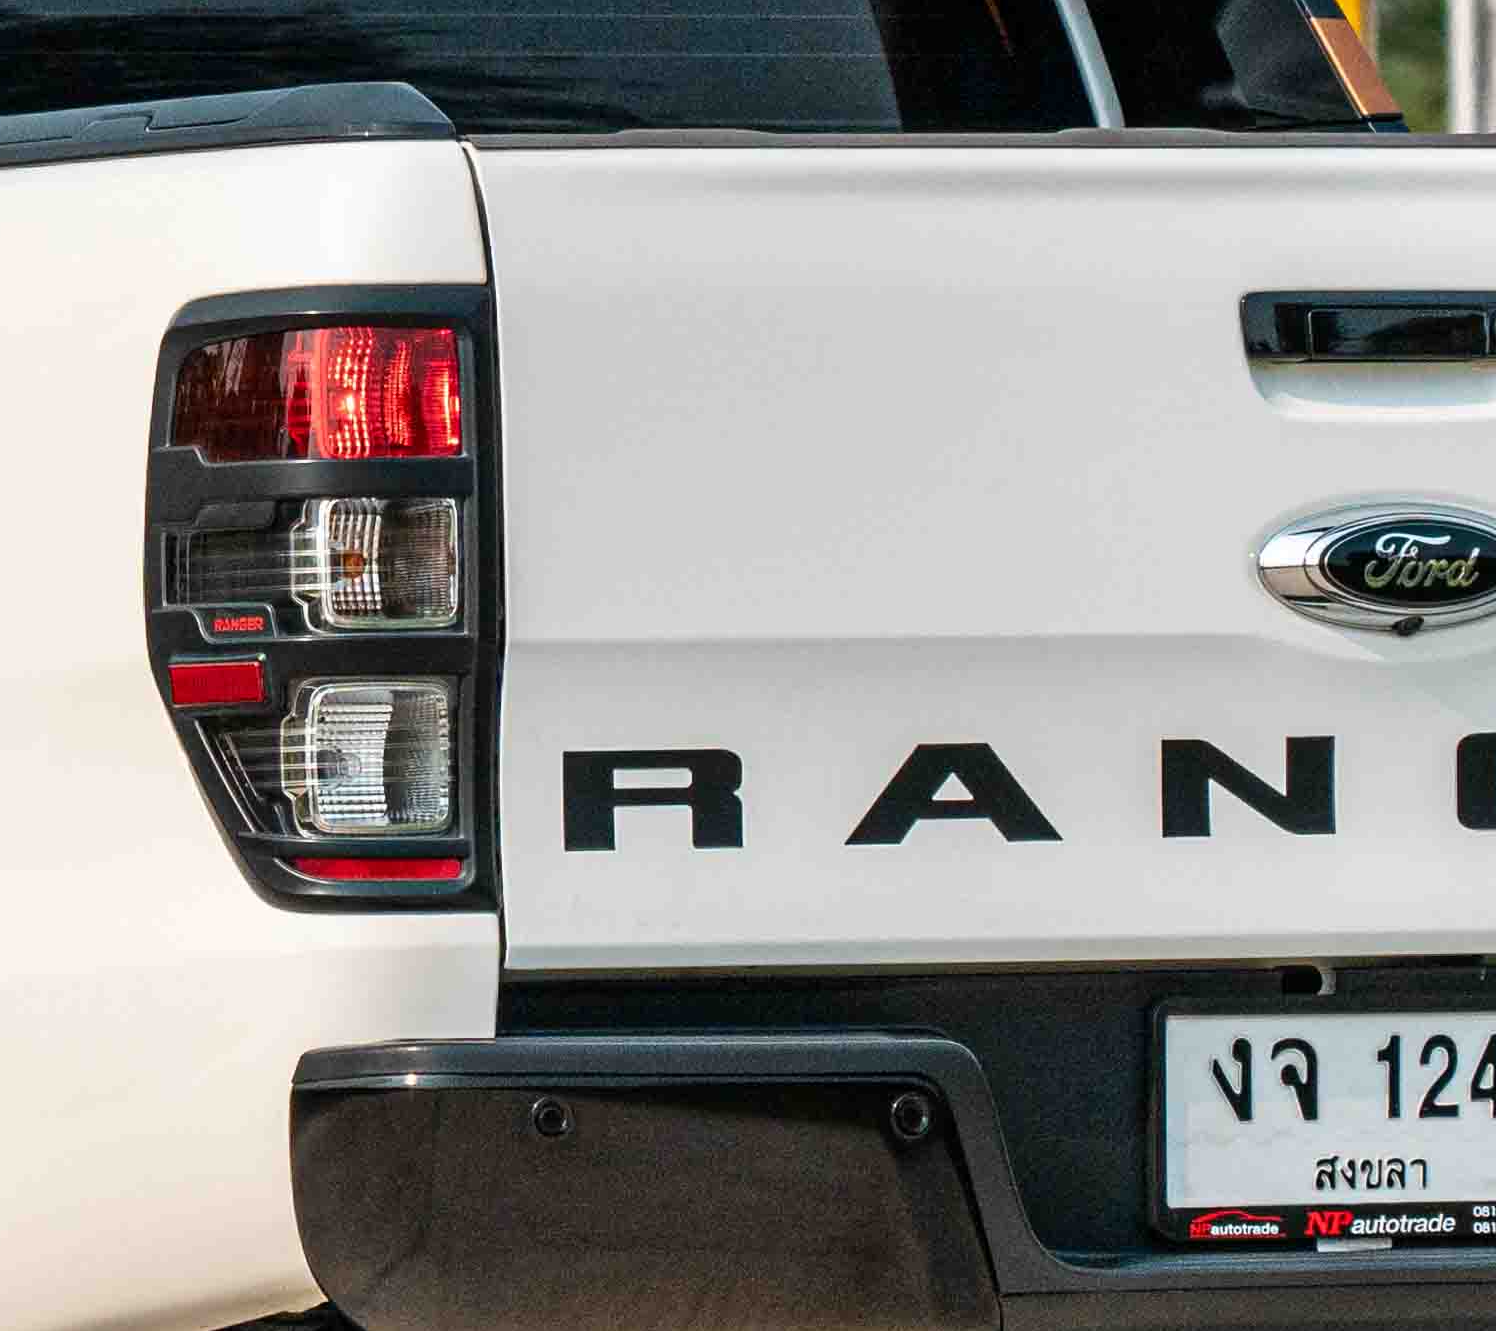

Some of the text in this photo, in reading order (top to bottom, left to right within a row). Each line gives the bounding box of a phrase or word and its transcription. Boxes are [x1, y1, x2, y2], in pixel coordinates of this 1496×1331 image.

[1364, 533, 1480, 588] Ford
[1210, 1038, 1318, 1122] งจ
[1315, 1157, 1428, 1190] สงขลา
